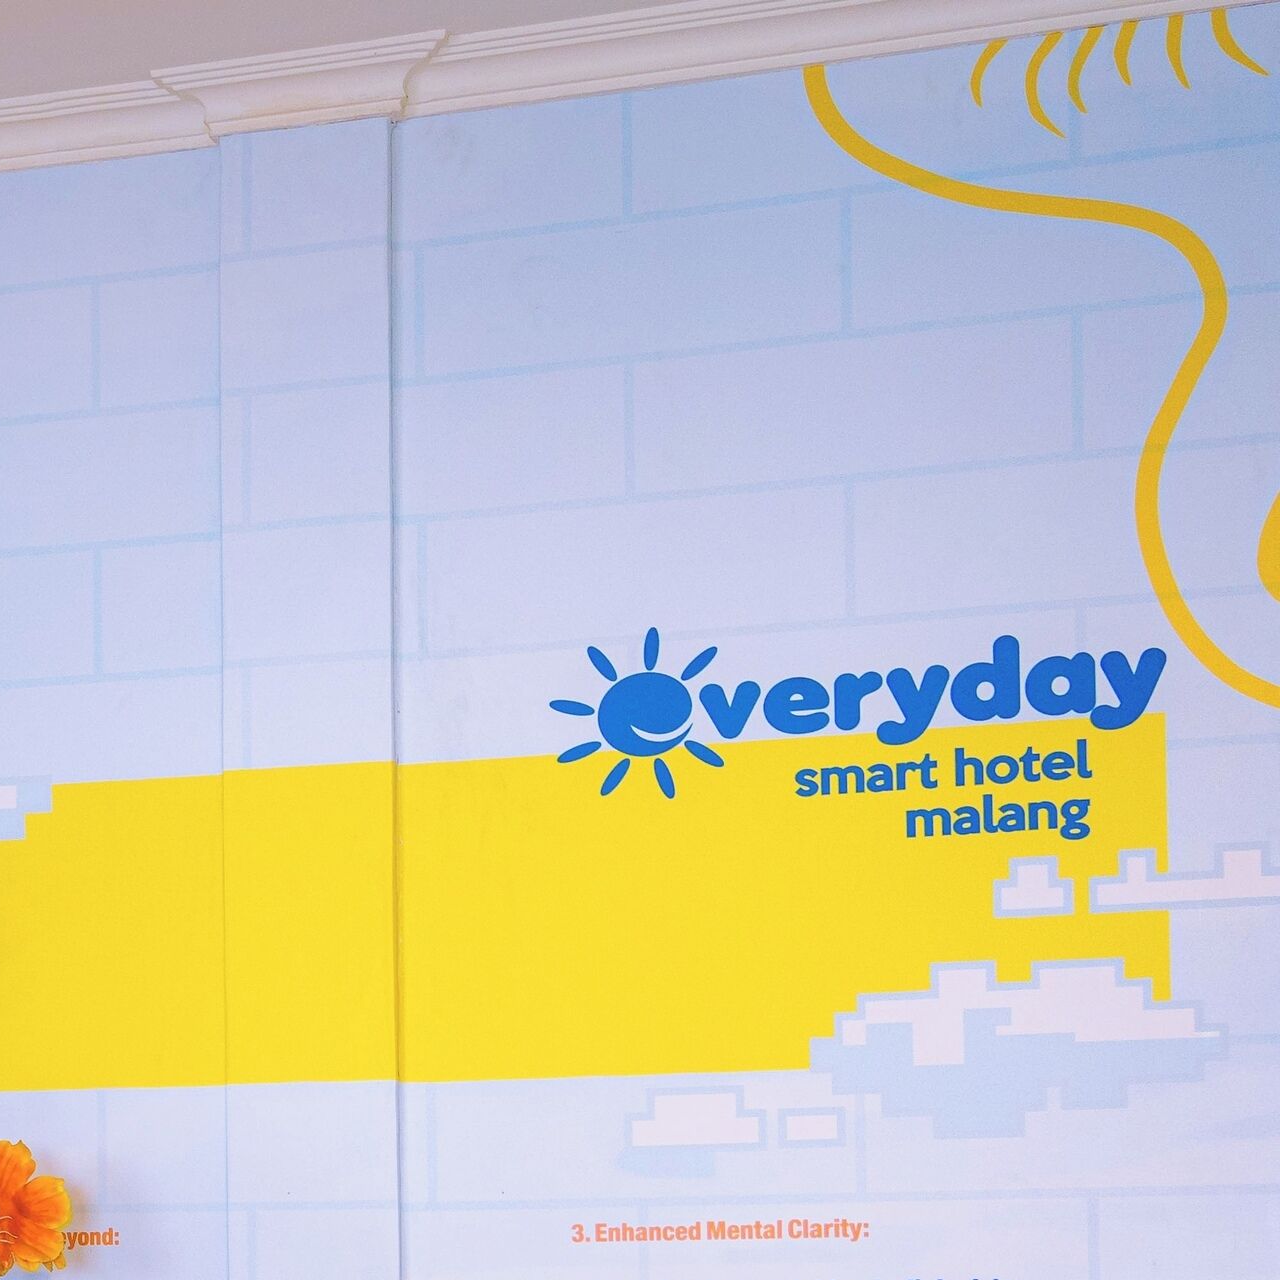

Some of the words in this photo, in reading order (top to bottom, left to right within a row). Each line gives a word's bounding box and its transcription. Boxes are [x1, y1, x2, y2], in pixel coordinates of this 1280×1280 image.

[794, 751, 939, 798] smart
[954, 738, 1093, 786] hotel
[905, 794, 1091, 841] malang
[571, 1224, 590, 1243] 3.
[594, 1222, 702, 1242] Enhanced
[706, 1220, 783, 1242] Mental
[787, 1219, 870, 1242] Clarity:
